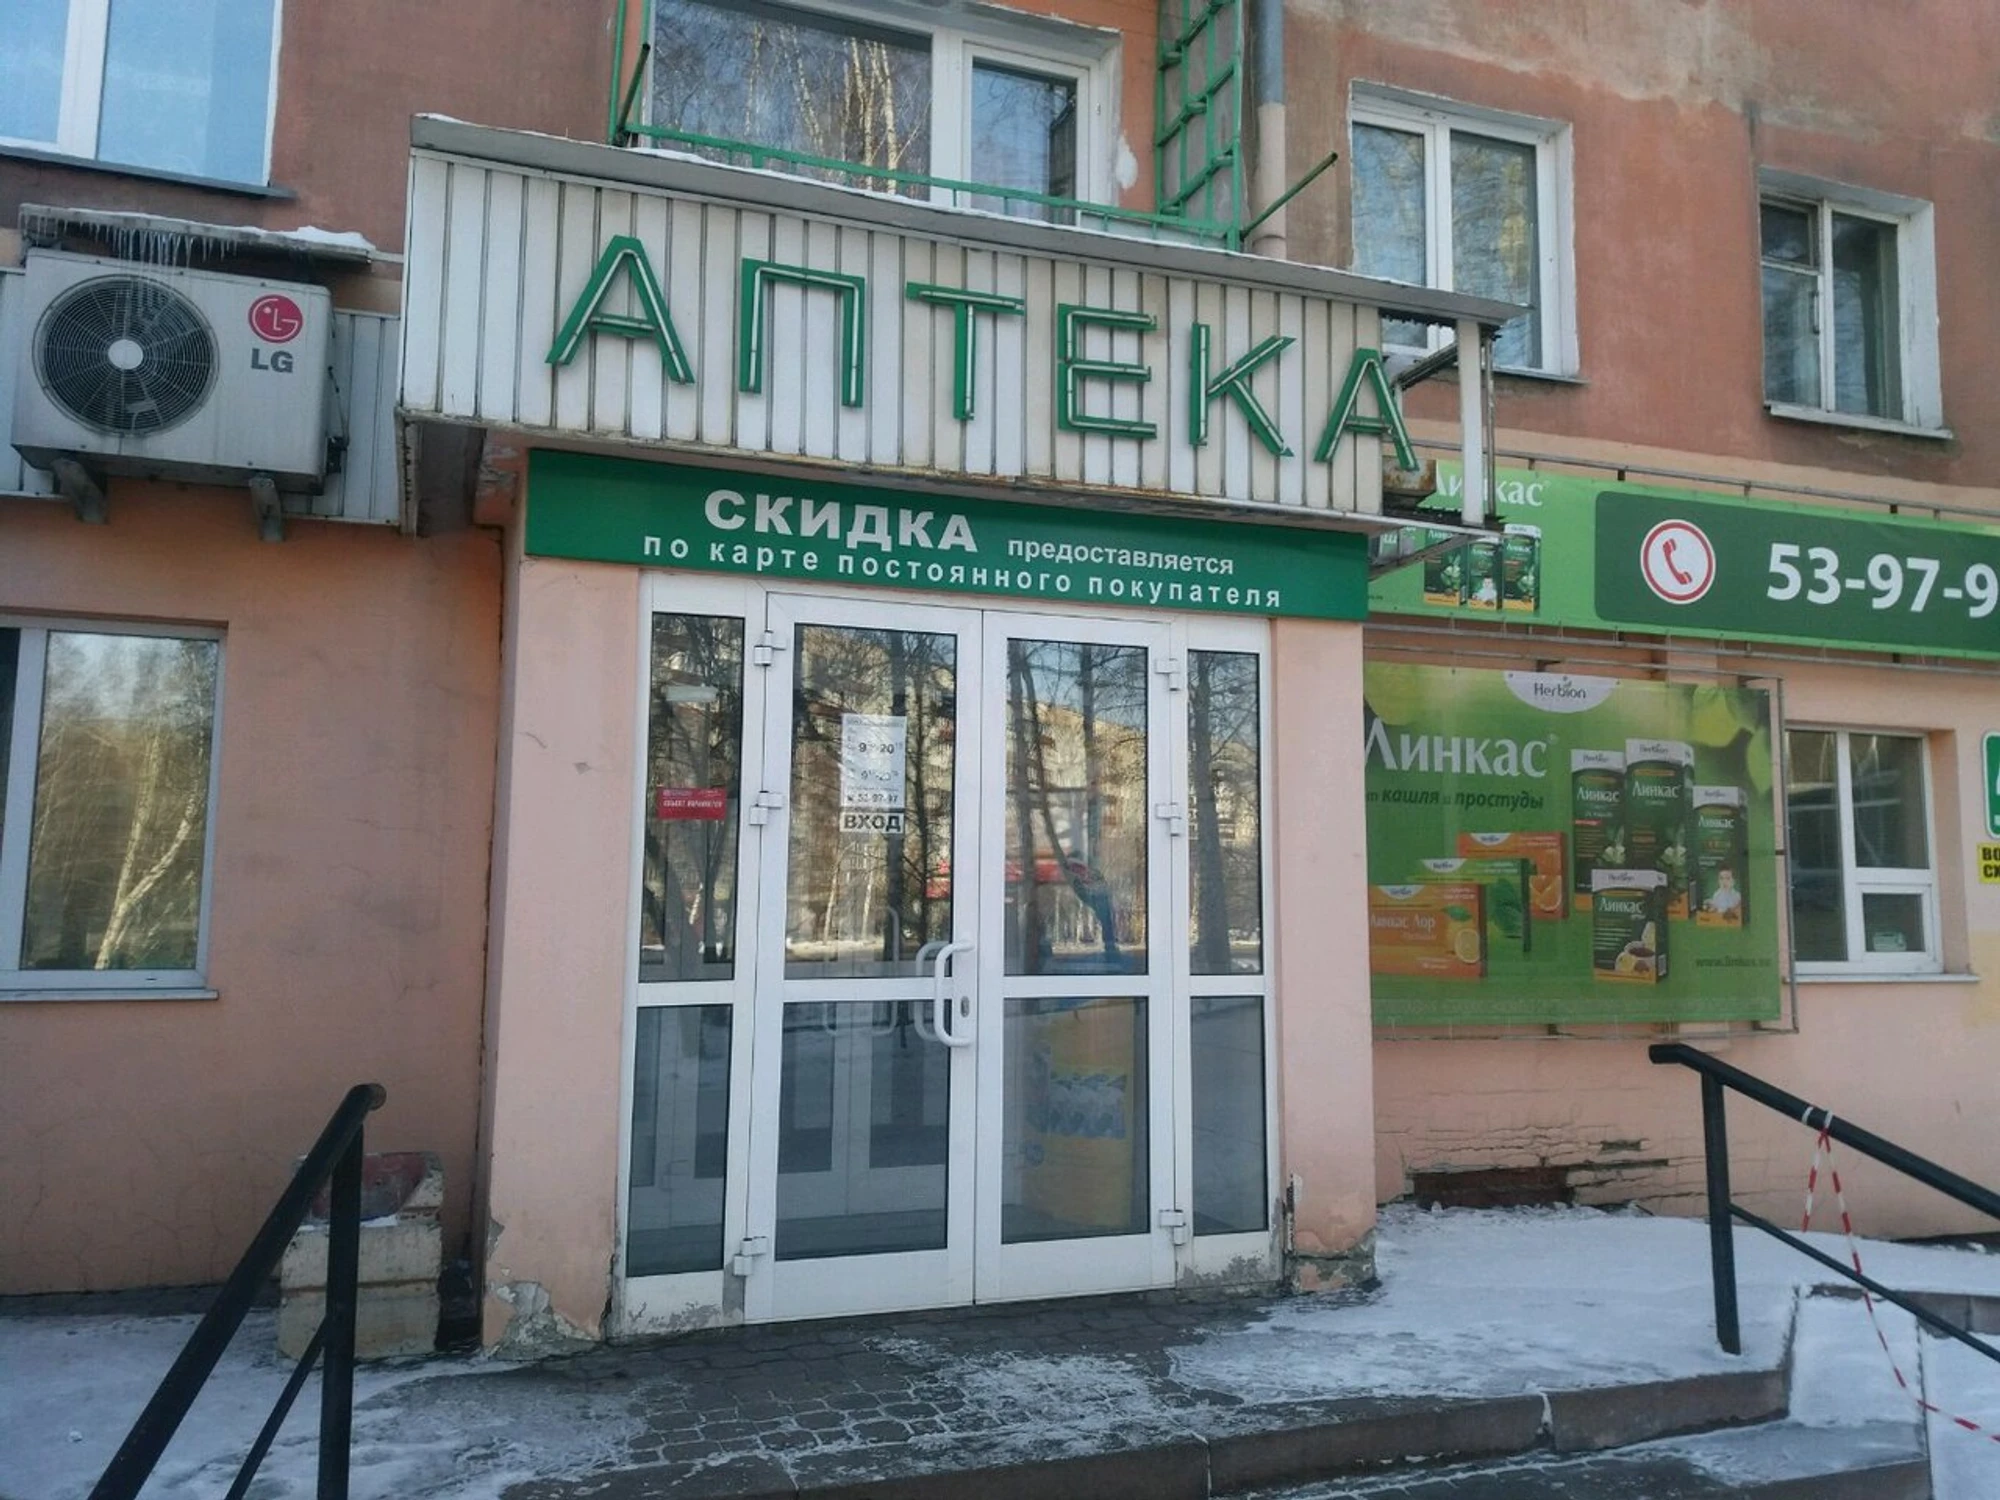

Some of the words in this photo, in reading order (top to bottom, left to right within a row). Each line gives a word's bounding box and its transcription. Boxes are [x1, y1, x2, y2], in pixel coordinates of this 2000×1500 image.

[251, 347, 294, 374] LG
[545, 234, 1419, 471] АПТЕКА
[704, 489, 978, 552] СКИДКА
[1008, 539, 1234, 575] предоставляется
[643, 536, 689, 559] по
[710, 542, 818, 571] карте
[838, 554, 1071, 593] постоянного
[1088, 576, 1280, 607] покупателя
[1767, 543, 1999, 618] 53-97-9
[1534, 680, 1586, 700] Herbion
[1364, 717, 1547, 778] Линкас
[1382, 788, 1440, 805] кашля
[1459, 790, 1544, 813] простуды
[1632, 780, 1680, 799] Линкас
[844, 814, 902, 832] ВХОД
[1598, 896, 1644, 916] Линкас
